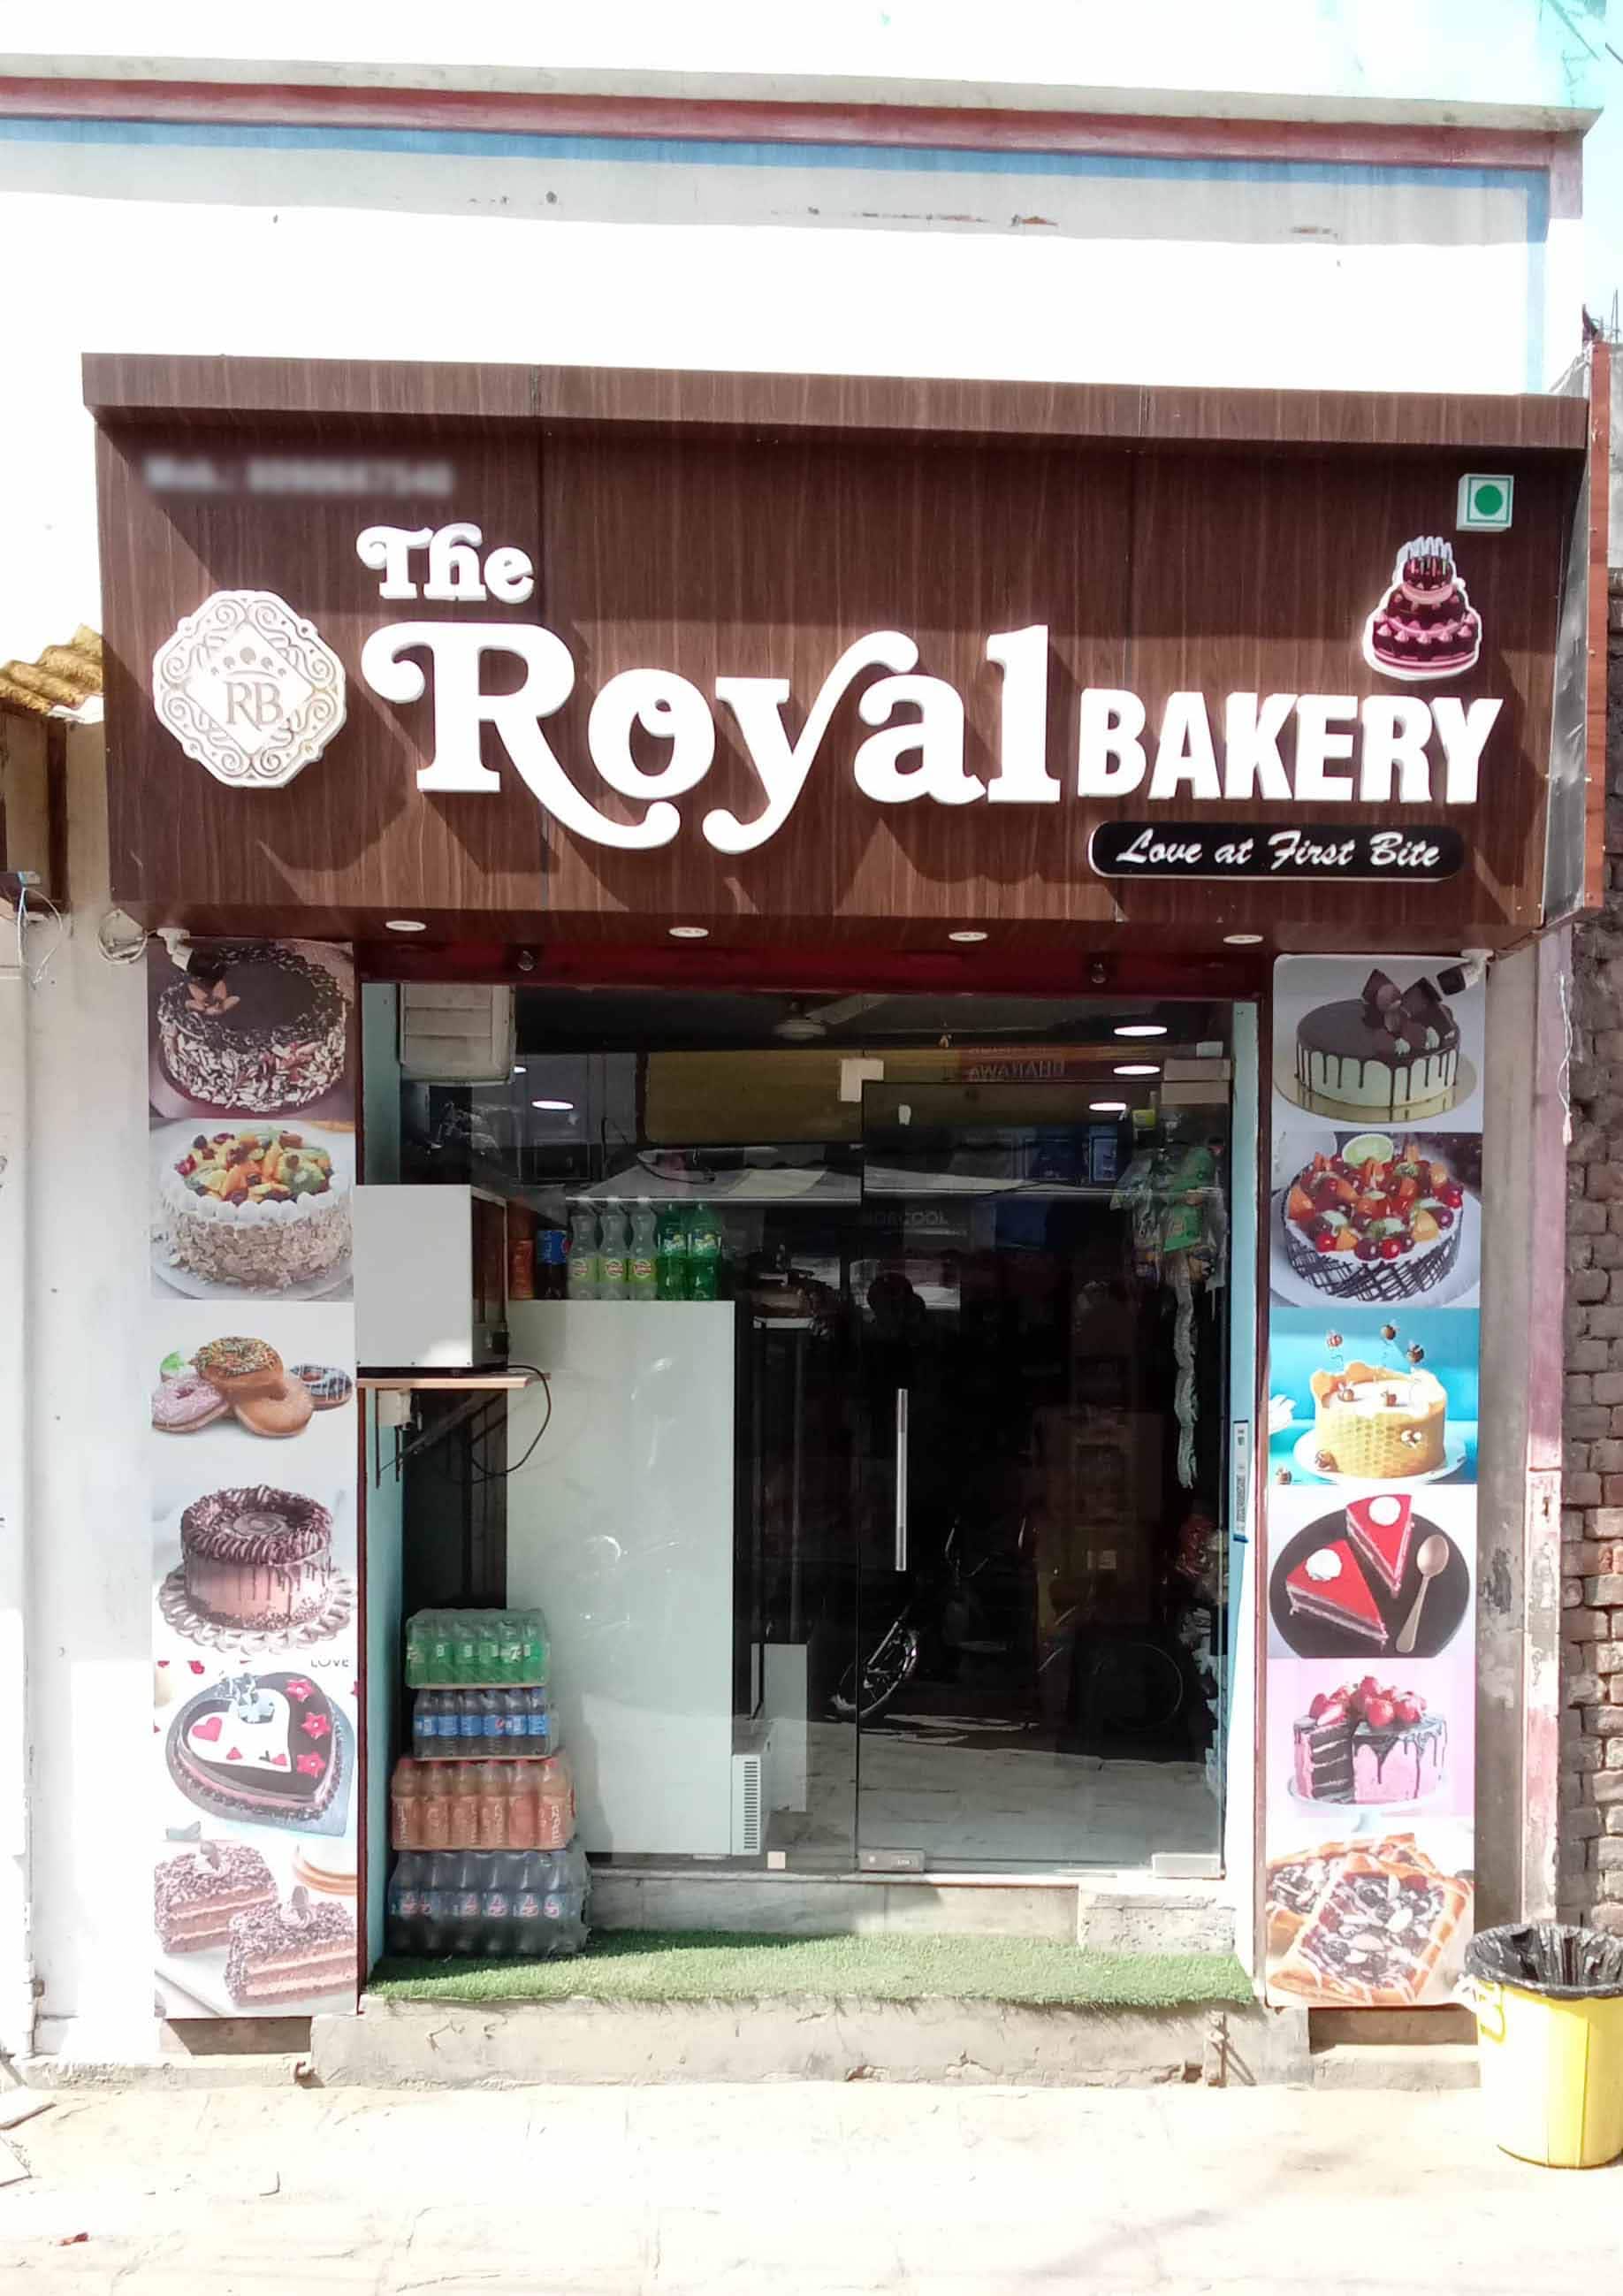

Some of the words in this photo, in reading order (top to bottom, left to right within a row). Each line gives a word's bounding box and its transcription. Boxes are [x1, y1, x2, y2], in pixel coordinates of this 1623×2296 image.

[356, 523, 535, 605] The
[224, 681, 283, 732] RB
[361, 622, 1061, 852] Royal
[1078, 688, 1504, 804] BAKERY
[1116, 828, 1203, 865] Love
[1214, 837, 1254, 865] at
[1267, 829, 1355, 871] First
[1368, 831, 1441, 867] Bite
